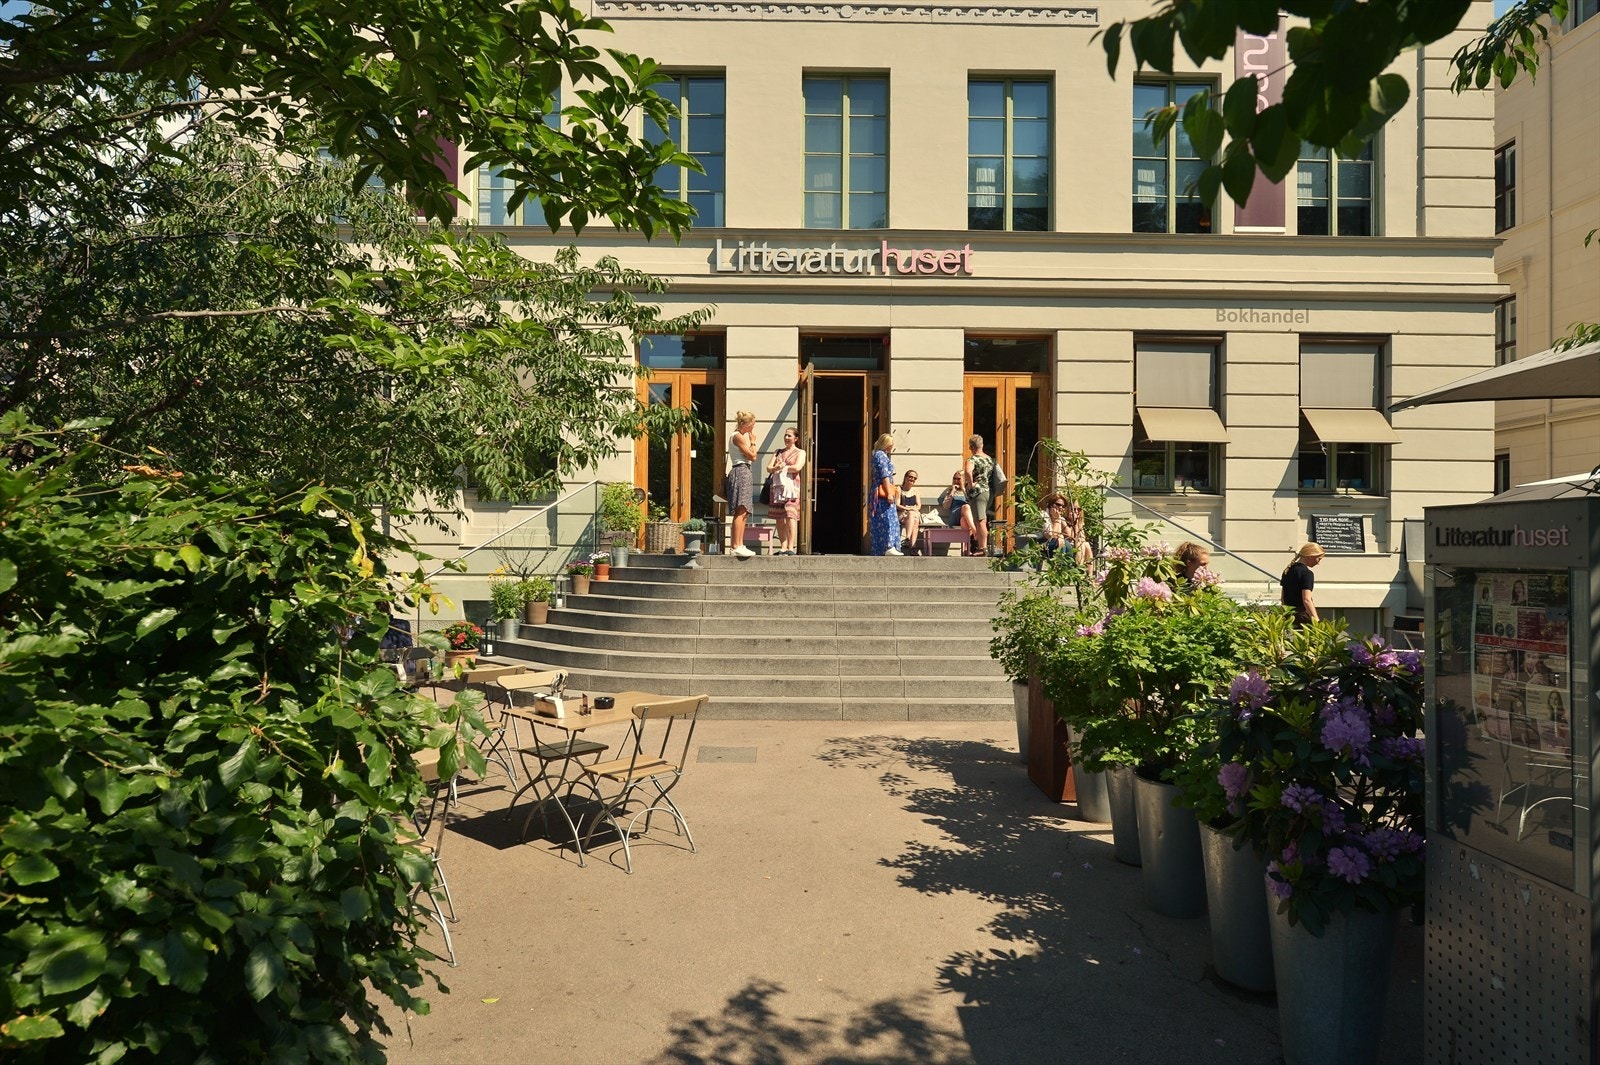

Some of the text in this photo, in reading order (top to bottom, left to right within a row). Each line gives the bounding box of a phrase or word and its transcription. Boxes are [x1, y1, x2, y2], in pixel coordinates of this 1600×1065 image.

[716, 239, 974, 274] Litteraturhuset
[1216, 307, 1310, 324] Bokhandel
[1435, 524, 1569, 547] Litteraturhuset
